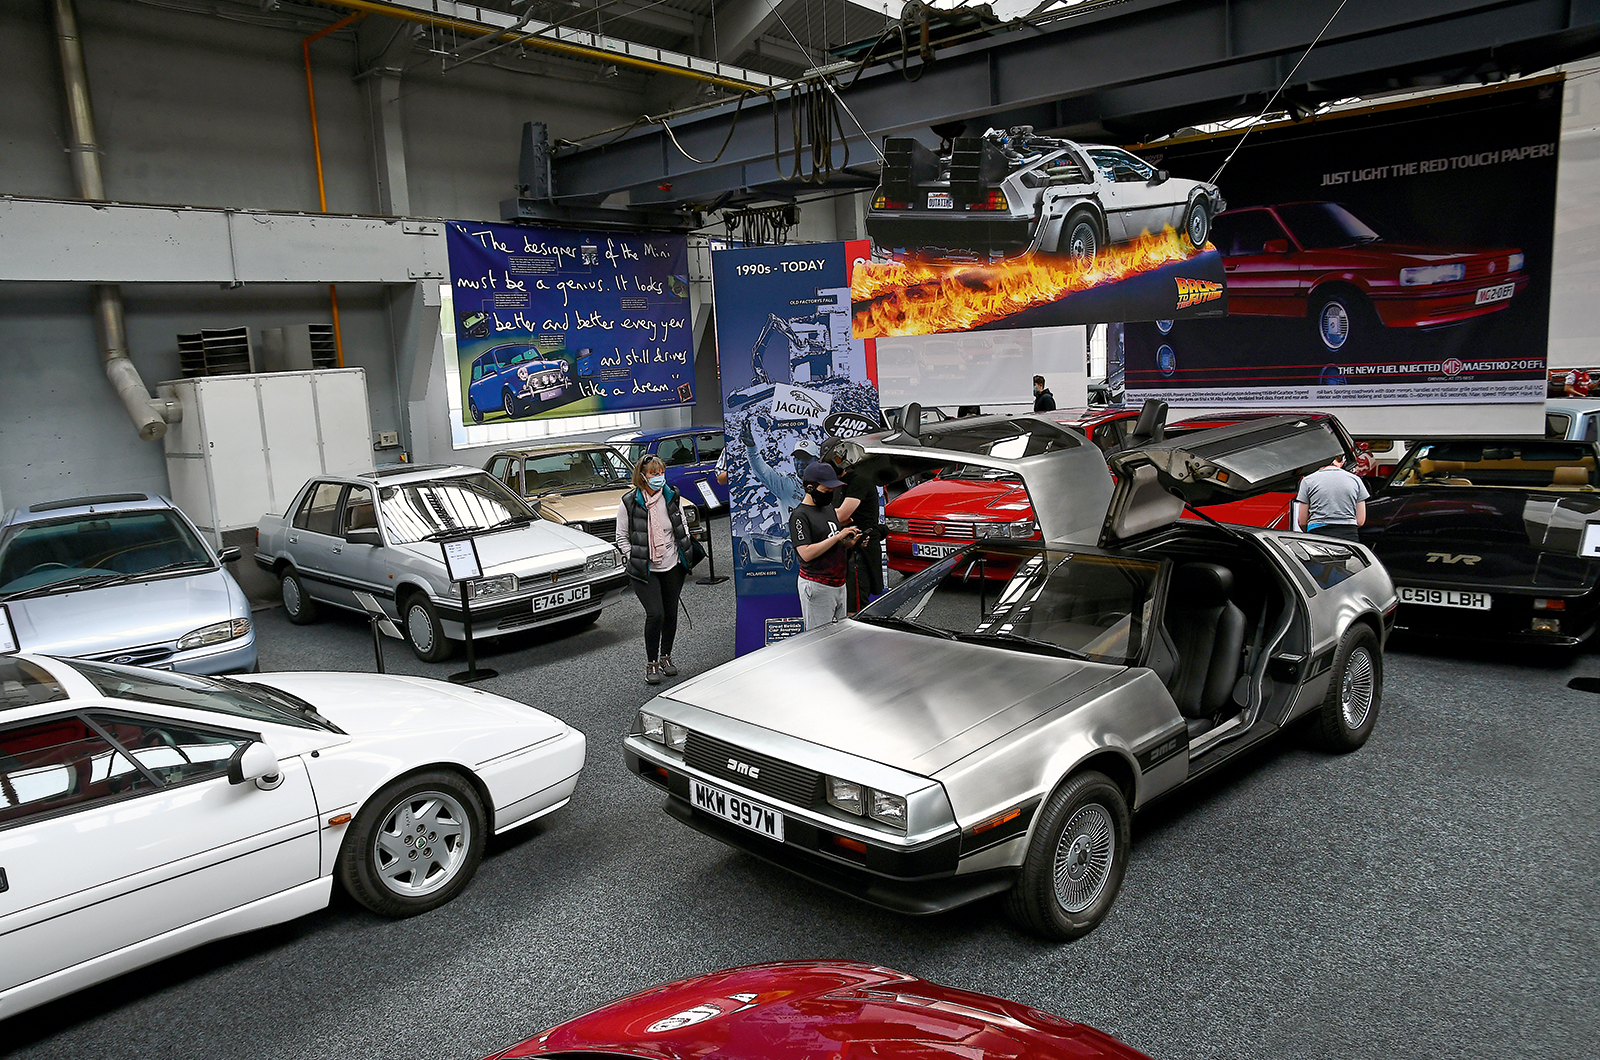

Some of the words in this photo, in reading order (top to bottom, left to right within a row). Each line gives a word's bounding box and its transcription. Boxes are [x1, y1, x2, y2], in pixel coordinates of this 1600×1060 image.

[1320, 171, 1350, 186] JUST
[1352, 166, 1389, 182] LIGHT
[1391, 162, 1418, 177] THE
[1420, 158, 1448, 173] RED
[1450, 150, 1499, 169] TOUCH
[1502, 143, 1555, 162] PAPER!
[524, 236, 577, 267] designer
[605, 238, 619, 267] of
[623, 244, 640, 260] the
[644, 244, 671, 258] Mini
[736, 264, 771, 276] 1990s
[780, 259, 826, 273] TODAY
[457, 270, 497, 289] must
[505, 270, 527, 291] be
[536, 280, 550, 290] a
[556, 280, 610, 306] genius.
[615, 275, 628, 290] It
[635, 276, 663, 294] looks
[1174, 277, 1223, 294] BACK
[1478, 290, 1491, 302] MG
[493, 312, 536, 332] better
[543, 312, 569, 331] and
[576, 310, 614, 330] better
[621, 320, 657, 342] every
[600, 348, 621, 366] and
[626, 348, 650, 365] still
[654, 348, 687, 364] drives
[1356, 366, 1376, 374] NEW
[1377, 365, 1399, 373] FUEL
[1400, 364, 1440, 372] INJECTED
[1443, 360, 1461, 374] MG
[1461, 361, 1510, 371] MAESTRO
[578, 382, 606, 397] like
[613, 386, 626, 395] a
[775, 401, 819, 418] JAGUAR
[834, 416, 867, 431] LAND
[918, 545, 940, 556] H321
[1425, 552, 1482, 566] TVR
[534, 593, 564, 610] E746
[568, 586, 588, 602] JCF
[1402, 589, 1442, 604] C519
[1447, 591, 1484, 608] LBH
[696, 783, 725, 815] MKW
[730, 798, 774, 835] 997W
